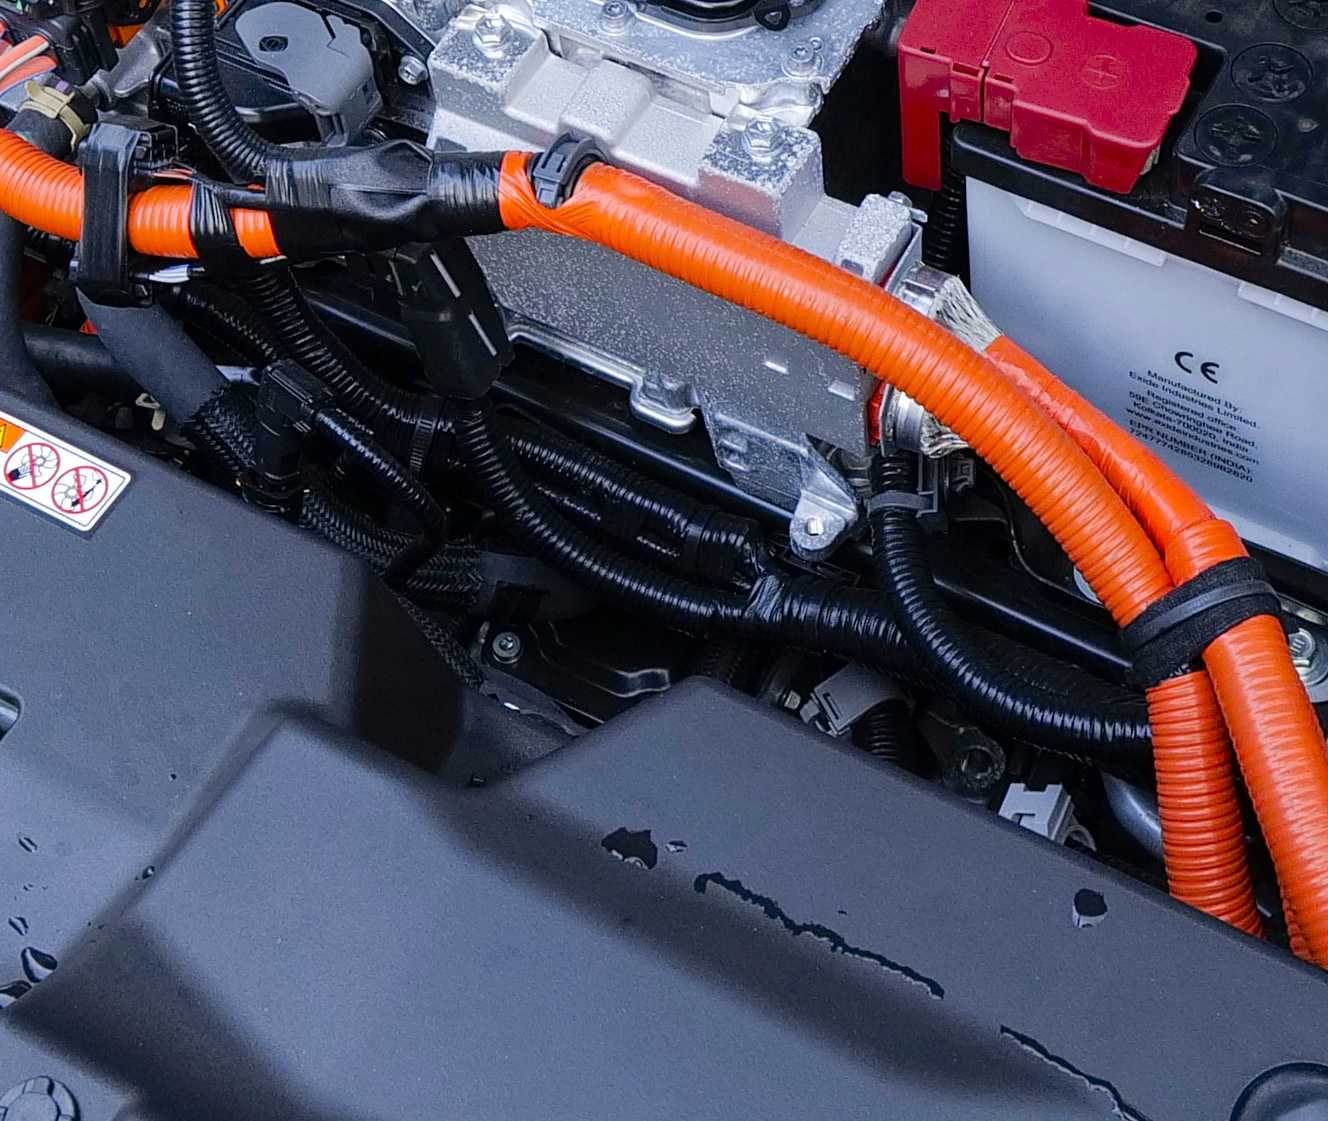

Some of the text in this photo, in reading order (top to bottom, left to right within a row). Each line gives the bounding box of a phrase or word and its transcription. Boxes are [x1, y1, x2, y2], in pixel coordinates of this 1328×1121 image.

[1174, 351, 1220, 384] CE
[1129, 371, 1159, 389] Exide
[1162, 385, 1214, 411] Industries
[1147, 369, 1221, 405] Manufactured
[1147, 390, 1204, 418] Registered
[1129, 419, 1154, 434] EPR
[1157, 430, 1207, 456] NUMBER
